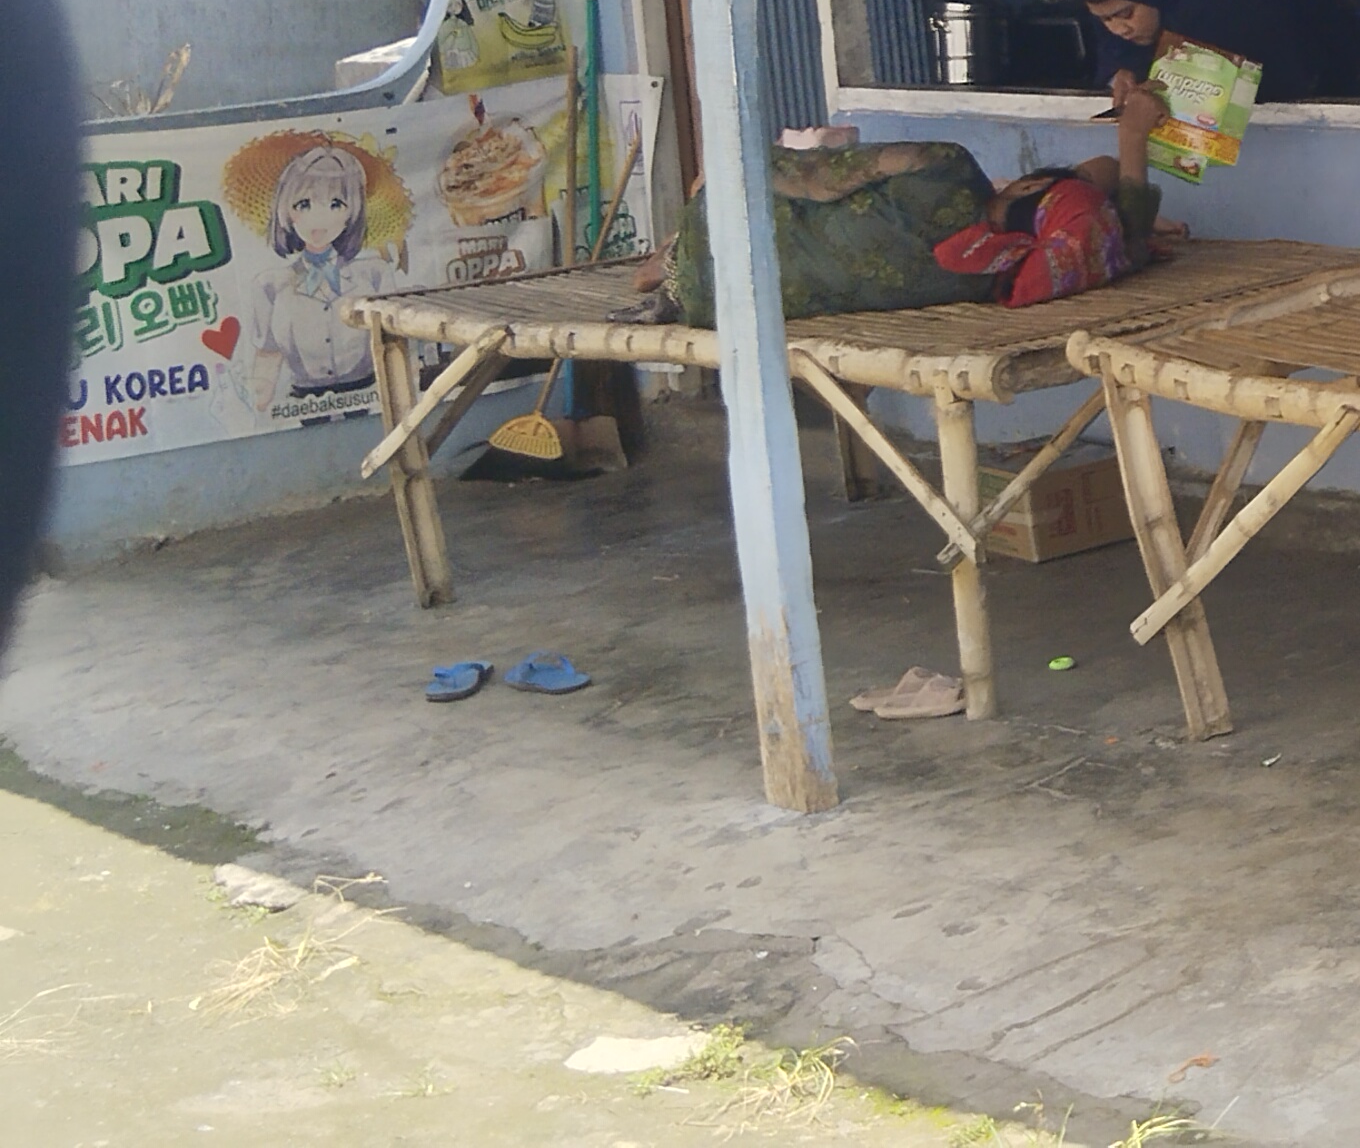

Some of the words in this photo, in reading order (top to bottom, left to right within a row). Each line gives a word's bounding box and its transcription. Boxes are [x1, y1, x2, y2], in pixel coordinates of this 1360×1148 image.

[448, 251, 519, 282] OPPA
[104, 364, 209, 404] KOREA
[59, 406, 147, 447] ENAK
